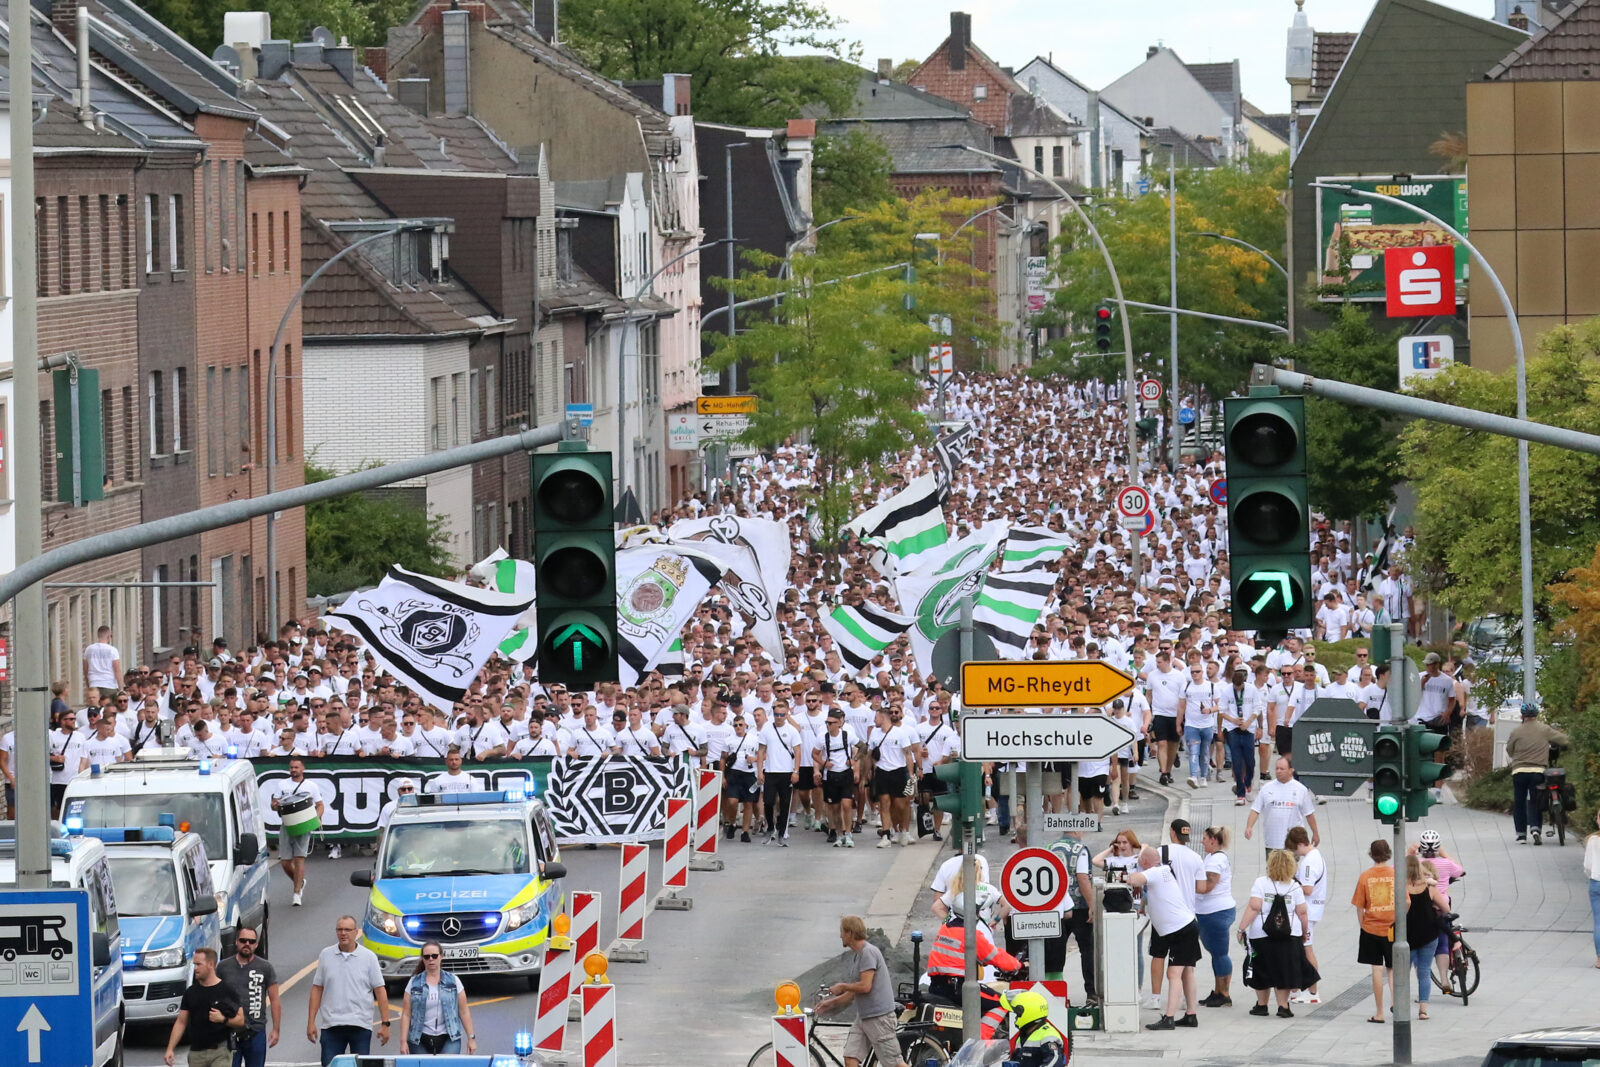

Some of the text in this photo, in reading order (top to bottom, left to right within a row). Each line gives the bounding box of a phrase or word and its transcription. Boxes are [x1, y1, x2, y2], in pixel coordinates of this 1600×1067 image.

[1376, 184, 1433, 196] SUBWAY
[1145, 386, 1157, 395] 30
[1124, 495, 1143, 510] 30
[988, 676, 1091, 696] MG-Rheydt
[987, 730, 1093, 746] Hochschule
[1309, 732, 1332, 745] RIOT
[1308, 743, 1336, 755] ULTRA
[1341, 750, 1365, 758] ULTRAS
[602, 770, 637, 815] B
[1047, 817, 1095, 828] Bahnstraße
[1015, 866, 1053, 896] 30
[415, 890, 488, 900] POLIZEI
[1016, 921, 1056, 931] Lärmschutz
[459, 949, 477, 957] 2499
